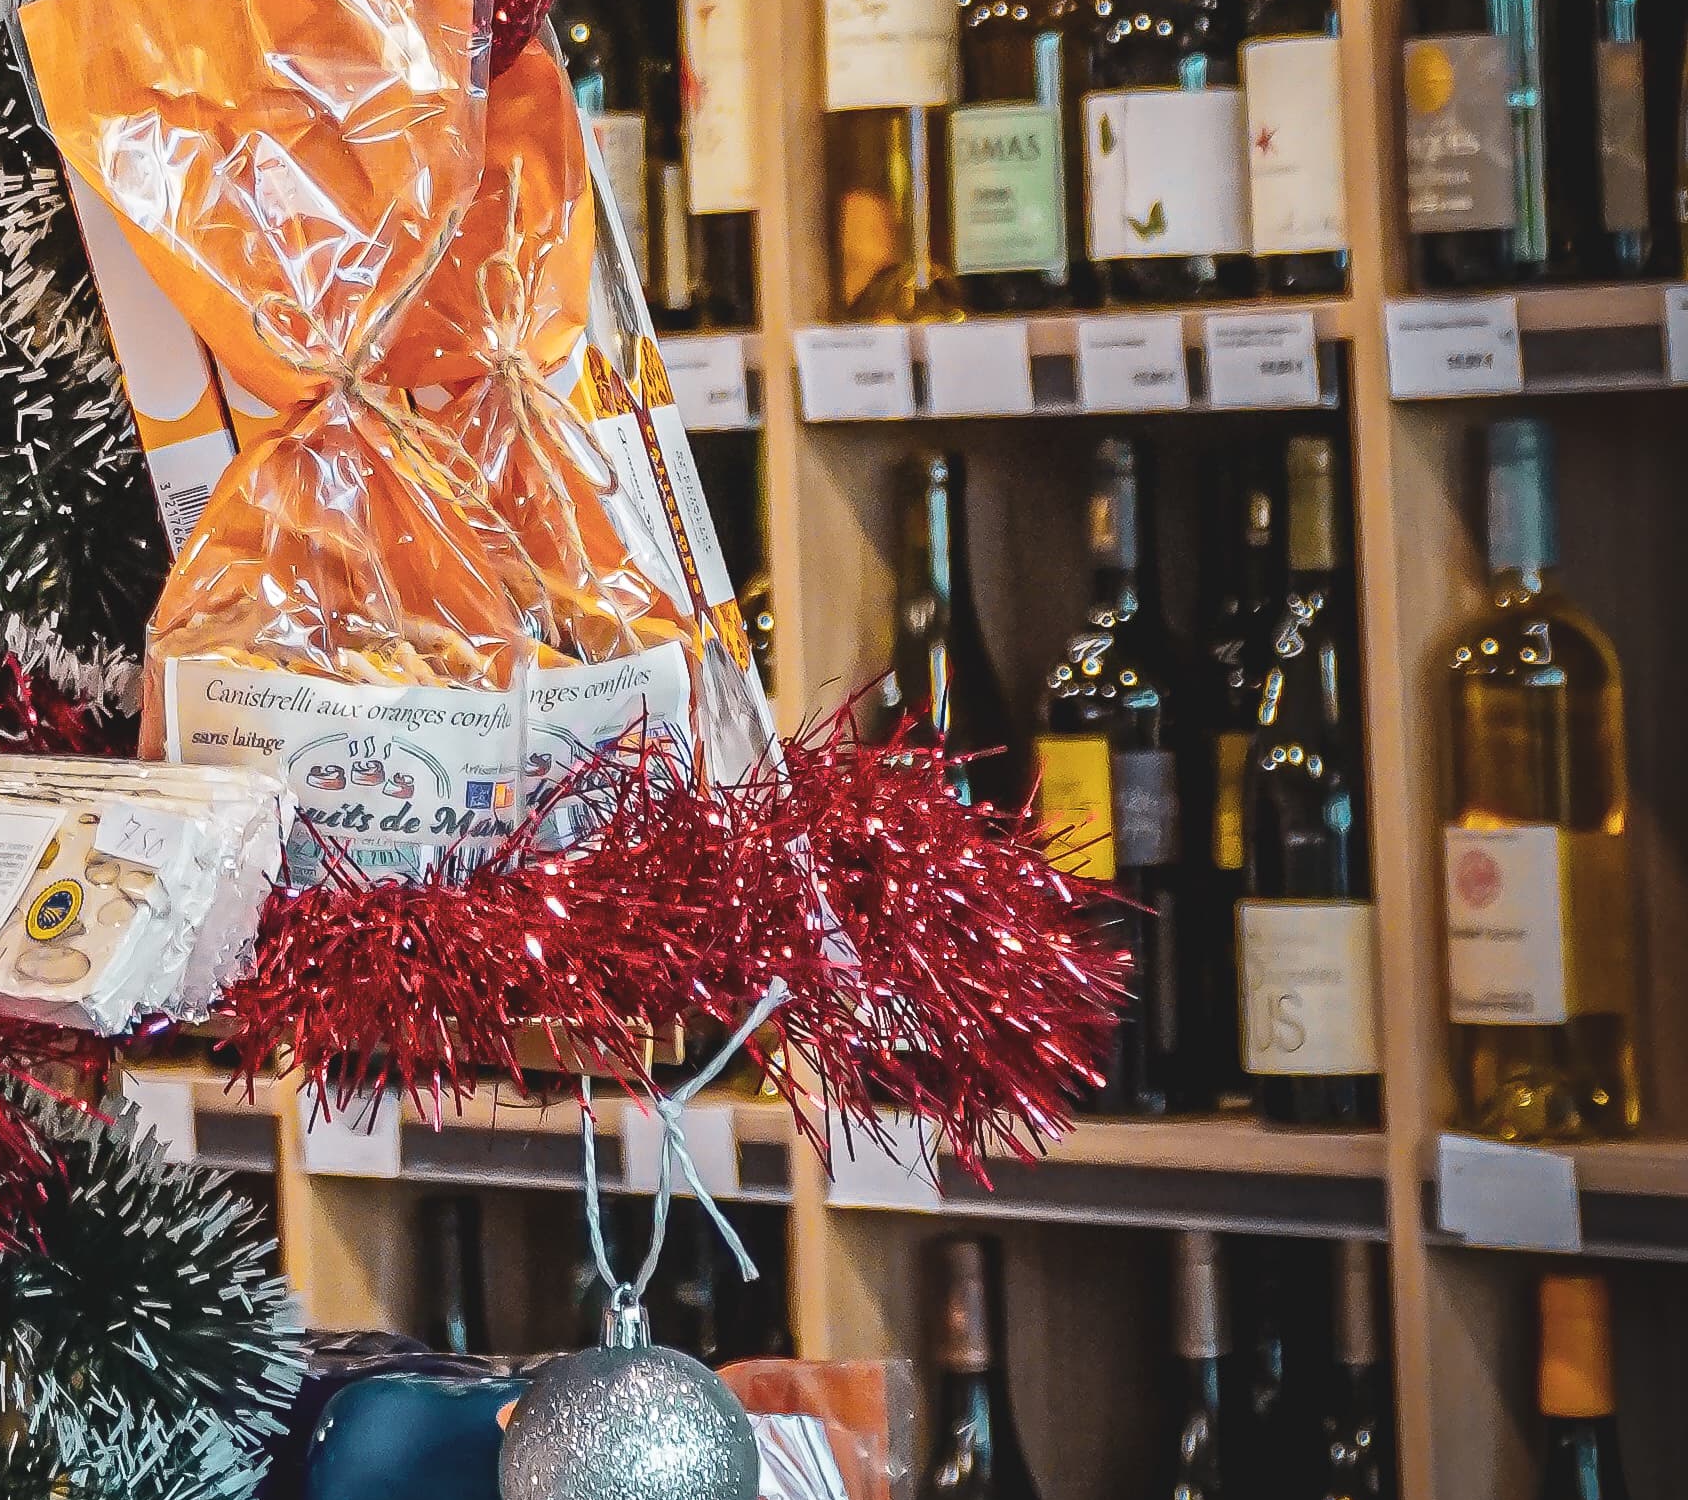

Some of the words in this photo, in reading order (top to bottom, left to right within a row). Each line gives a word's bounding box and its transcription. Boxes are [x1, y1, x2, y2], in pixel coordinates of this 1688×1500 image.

[159, 481, 171, 490] 3
[205, 679, 316, 714] Canistrelli
[317, 699, 364, 719] aux
[367, 705, 444, 732] oranges
[450, 702, 515, 737] confit
[529, 684, 579, 713] nges
[192, 730, 228, 747] sans
[232, 726, 286, 756] laitage
[297, 803, 375, 833] uits
[379, 801, 421, 834] de
